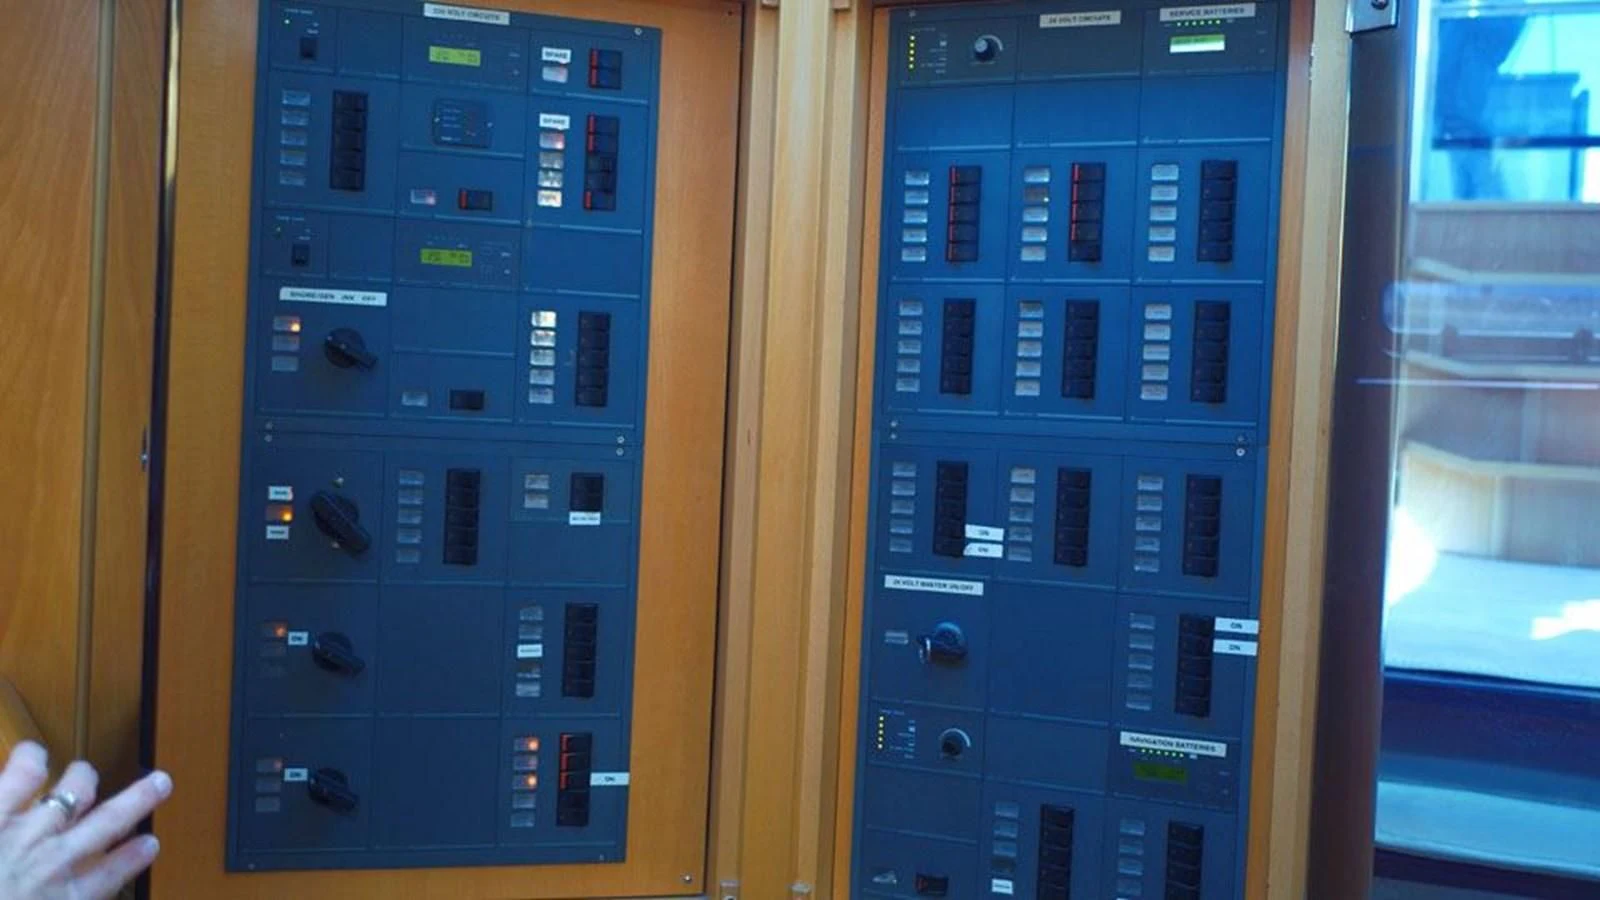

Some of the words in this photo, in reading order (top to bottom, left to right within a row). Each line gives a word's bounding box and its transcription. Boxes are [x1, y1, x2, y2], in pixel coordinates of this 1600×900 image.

[1169, 9, 1202, 17] SERVICE
[1203, 7, 1245, 16] BATTERIES
[1058, 15, 1077, 23] VOLT
[1129, 736, 1174, 748] NAVIGATION
[1175, 740, 1217, 752] BATTERIES
